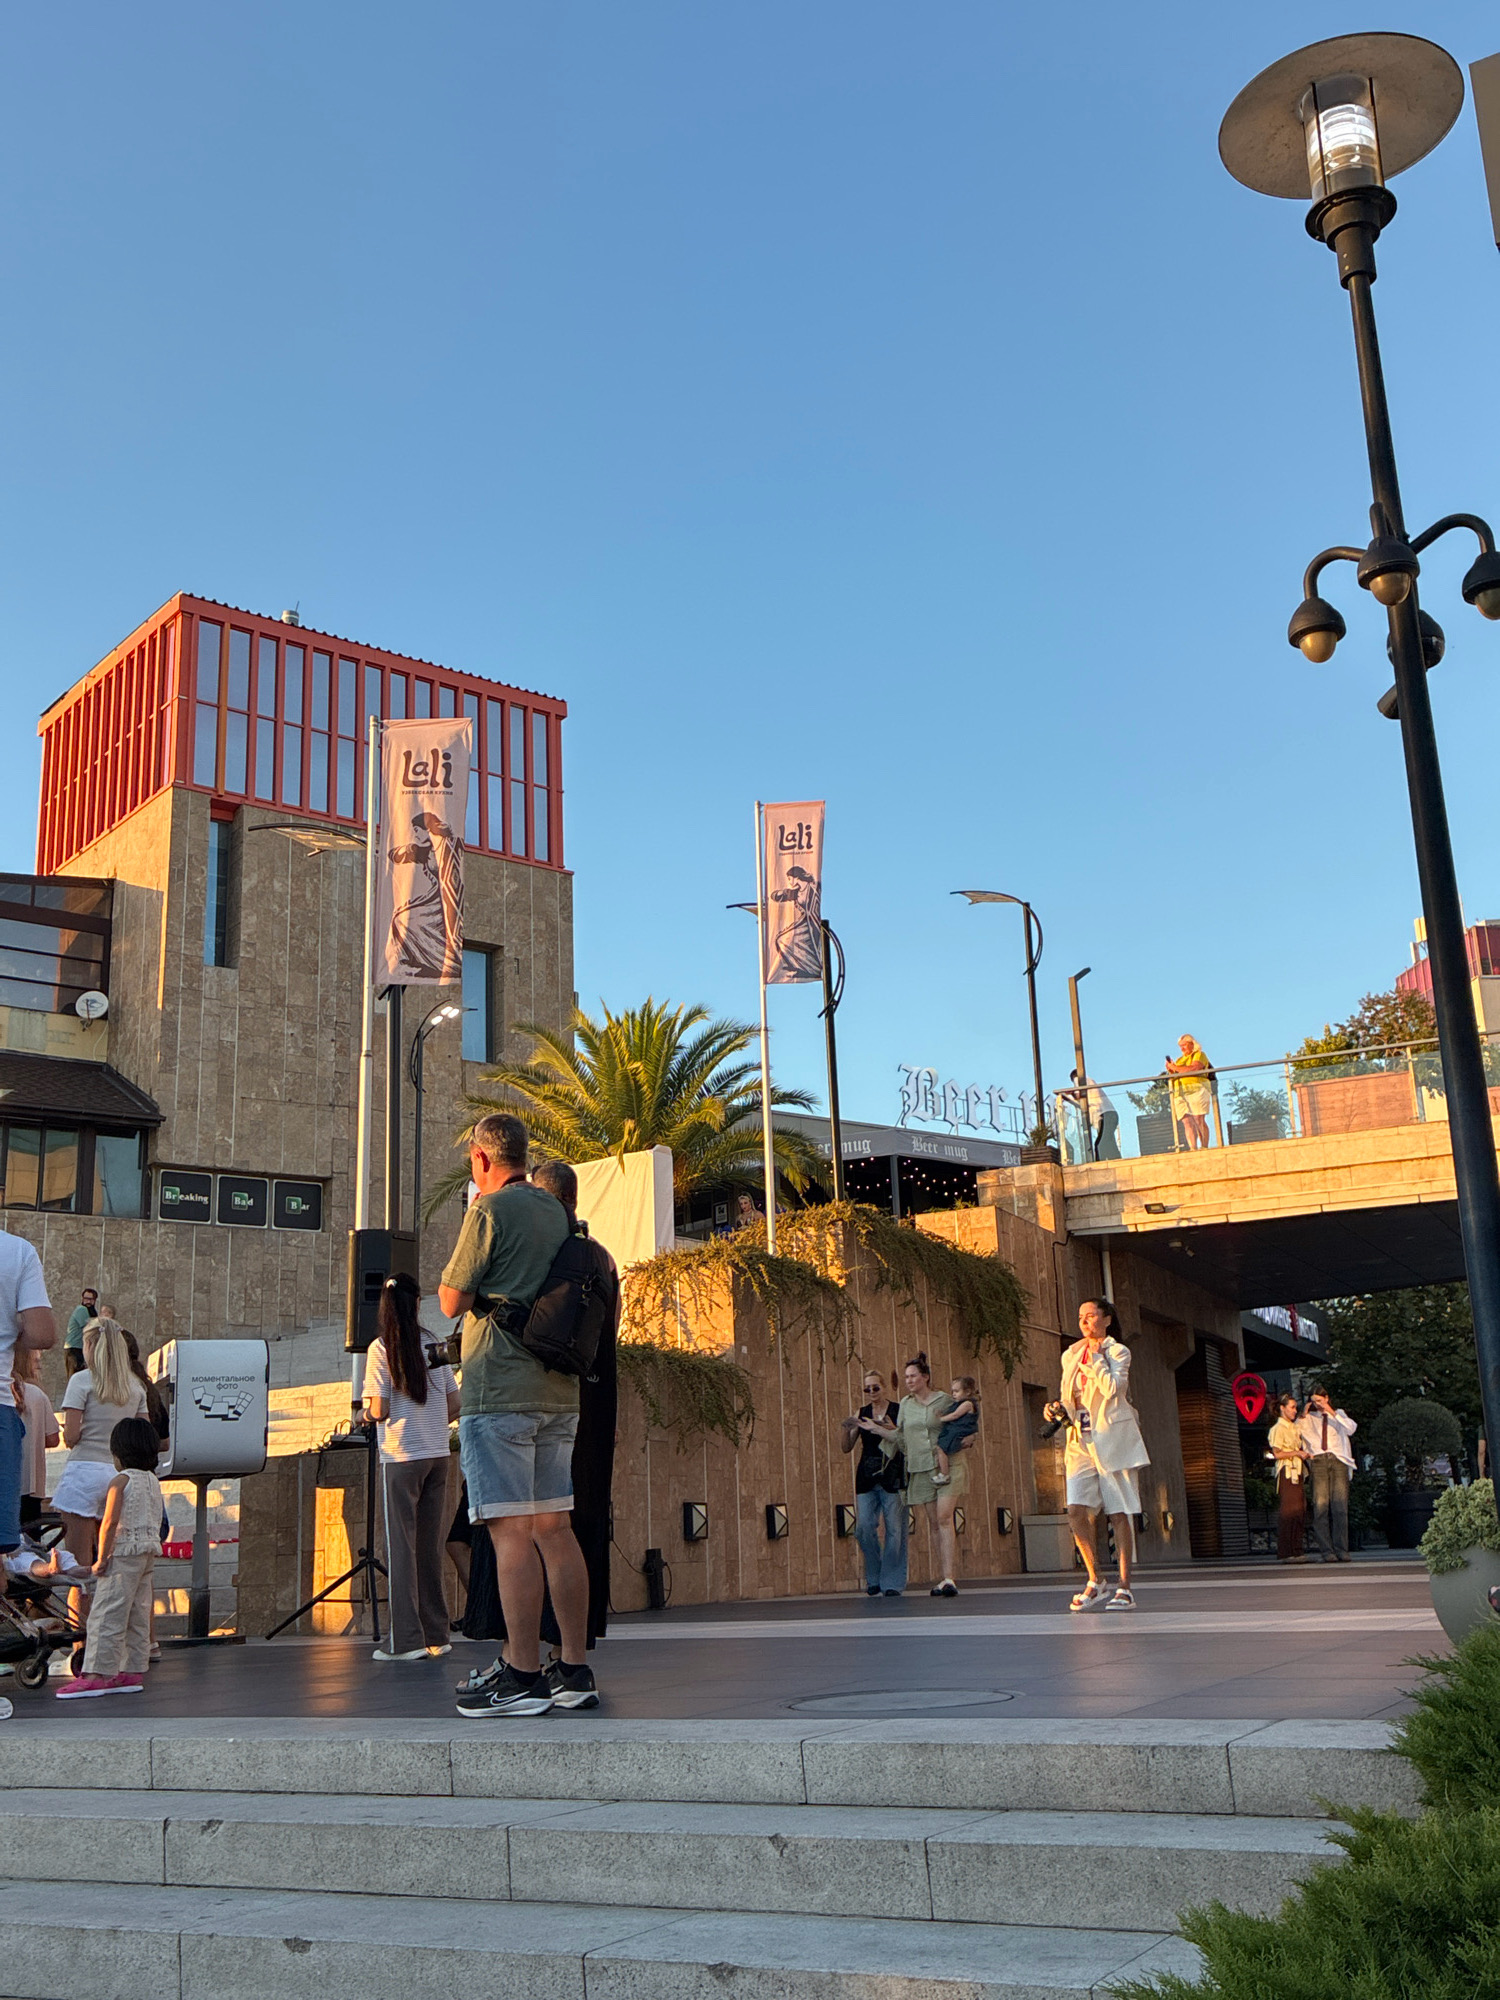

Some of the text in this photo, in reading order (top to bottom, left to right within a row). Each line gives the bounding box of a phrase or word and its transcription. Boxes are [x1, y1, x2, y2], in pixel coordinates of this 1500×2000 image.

[402, 748, 453, 788] Lali
[778, 822, 813, 850] Lali
[898, 1063, 1009, 1133] Beer
[911, 1135, 968, 1162] Beer mug
[165, 1191, 310, 1211] Breaking Bad Bar
[191, 1375, 256, 1383] моментальное
[216, 1383, 238, 1391] фото
